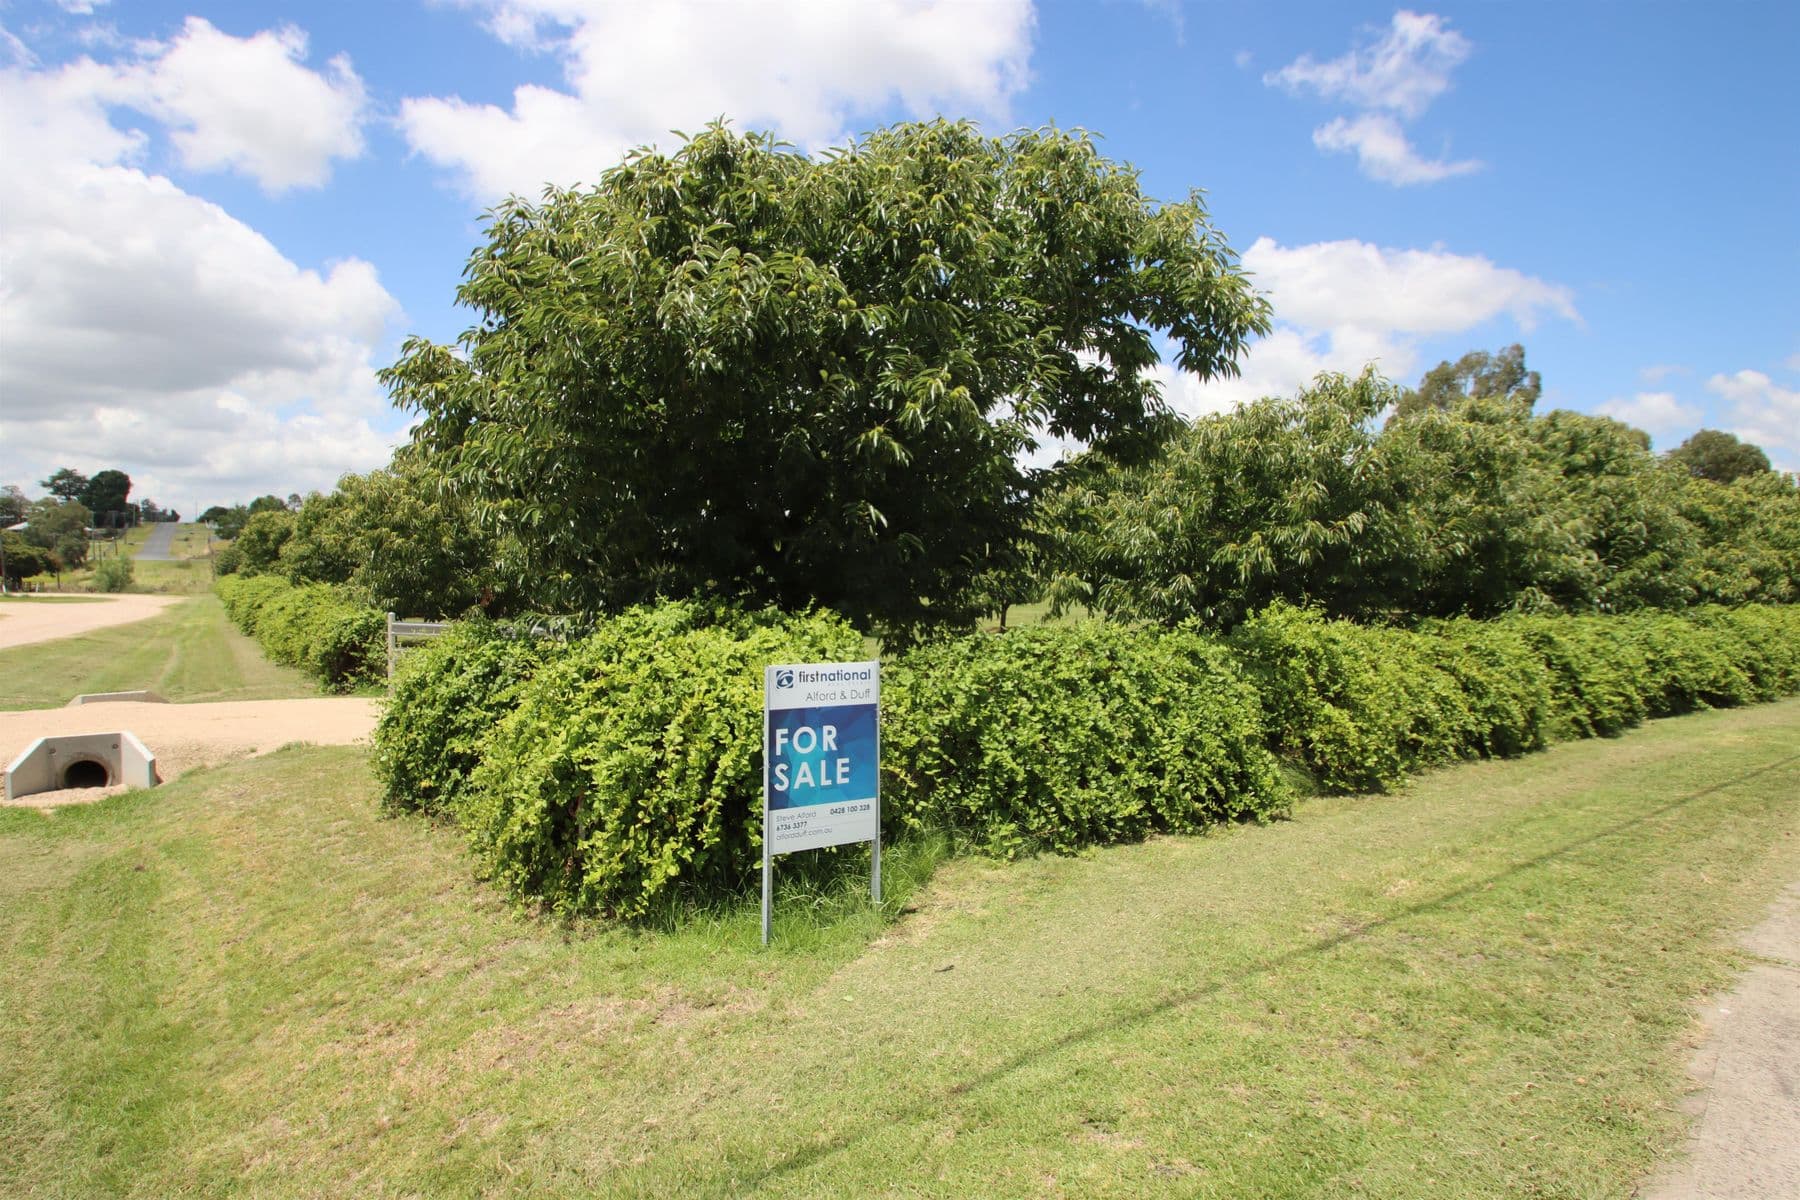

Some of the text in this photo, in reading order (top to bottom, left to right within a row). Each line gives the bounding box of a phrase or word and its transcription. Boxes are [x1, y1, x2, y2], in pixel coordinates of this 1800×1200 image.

[805, 688, 871, 702] Alford & Duff
[775, 725, 838, 756] FOR
[774, 758, 850, 791] SALE
